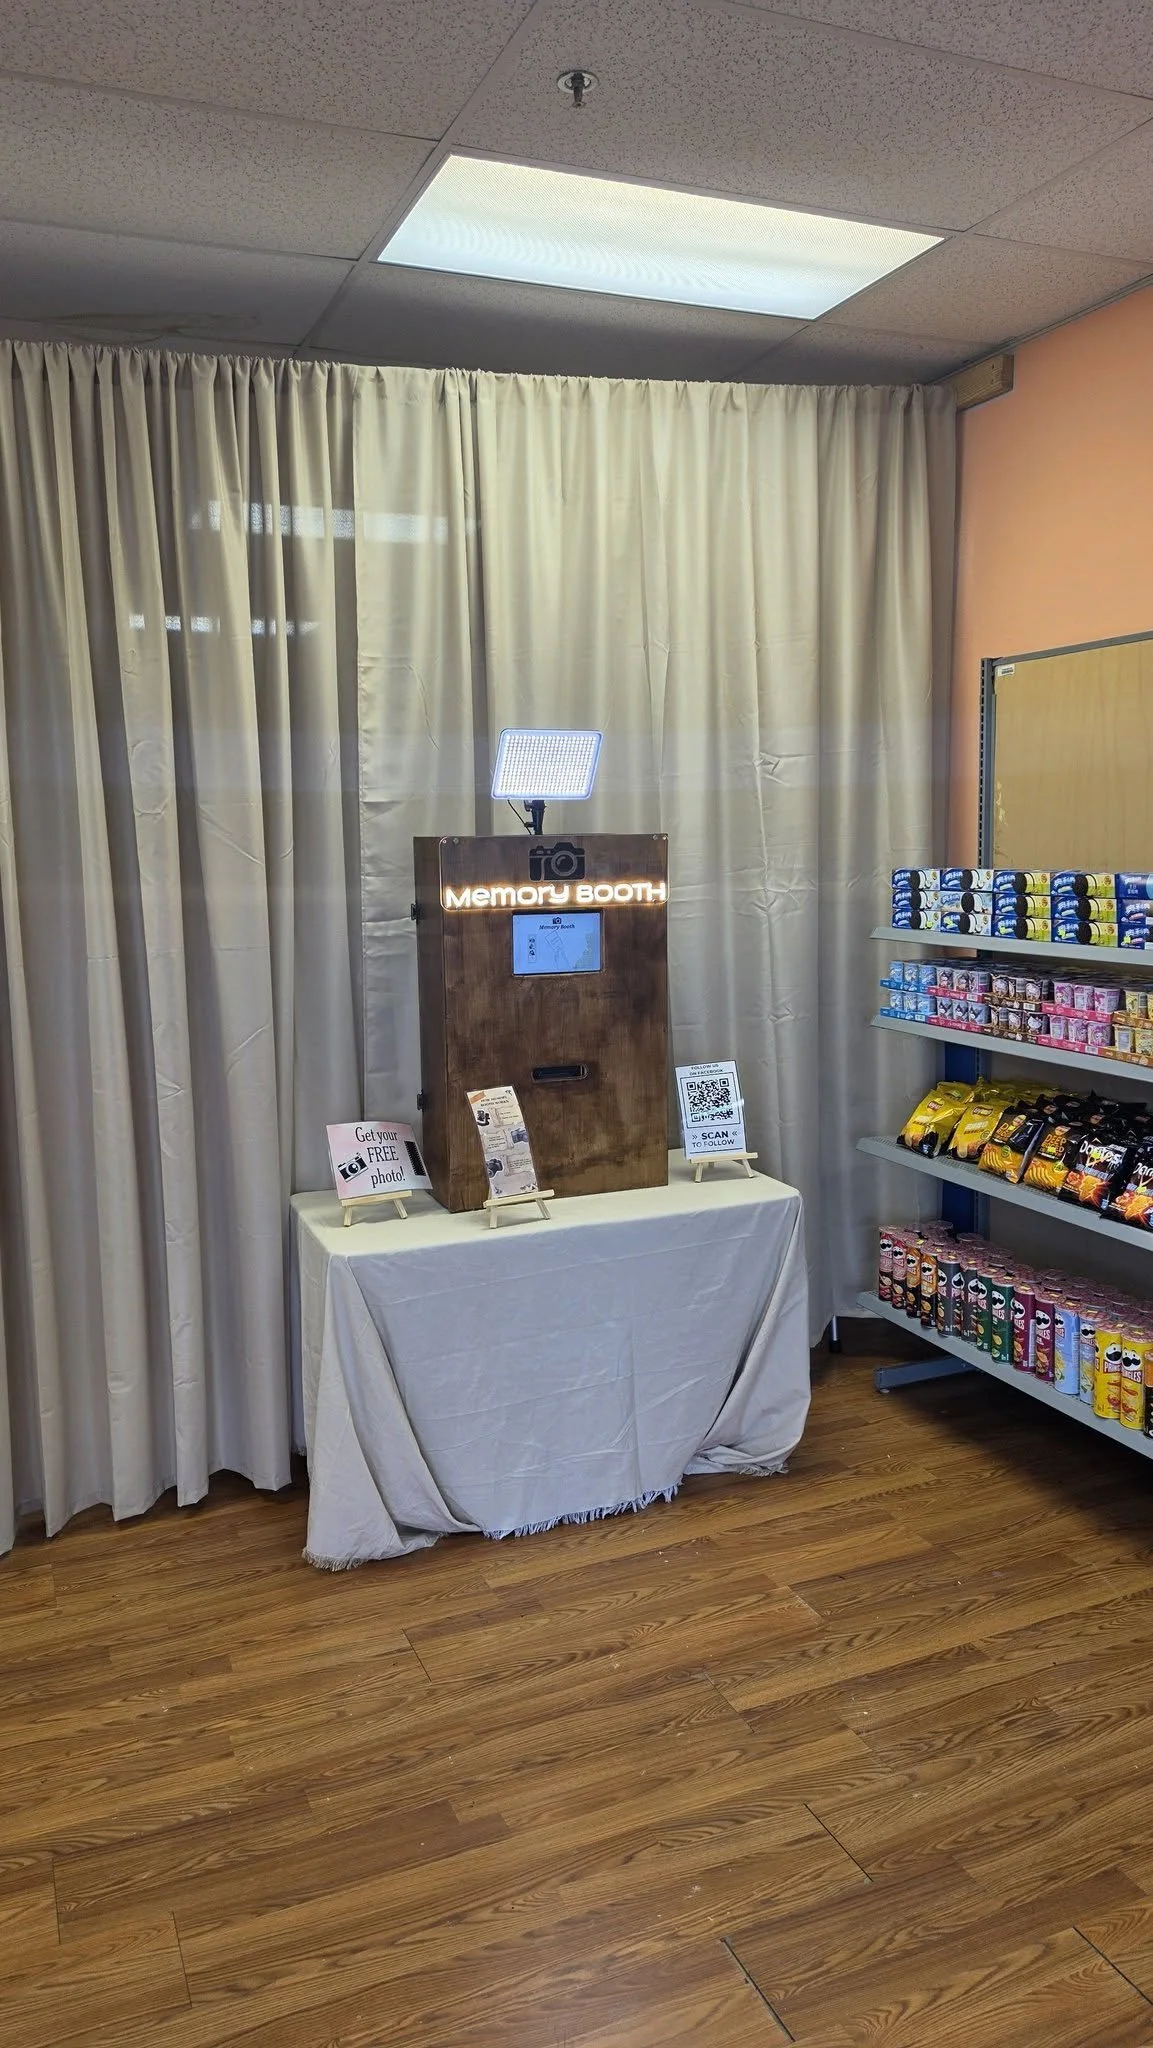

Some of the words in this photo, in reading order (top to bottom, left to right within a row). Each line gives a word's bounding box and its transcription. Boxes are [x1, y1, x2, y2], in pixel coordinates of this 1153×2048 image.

[576, 882, 666, 902] BOOTH
[355, 1127, 376, 1142] Get
[377, 1131, 398, 1144] your
[701, 1131, 729, 1140] SCAN
[704, 1139, 735, 1147] FOLLOW
[1045, 1134, 1067, 1145] DEEP
[367, 1146, 399, 1163] FREE
[370, 1166, 406, 1188] photo!
